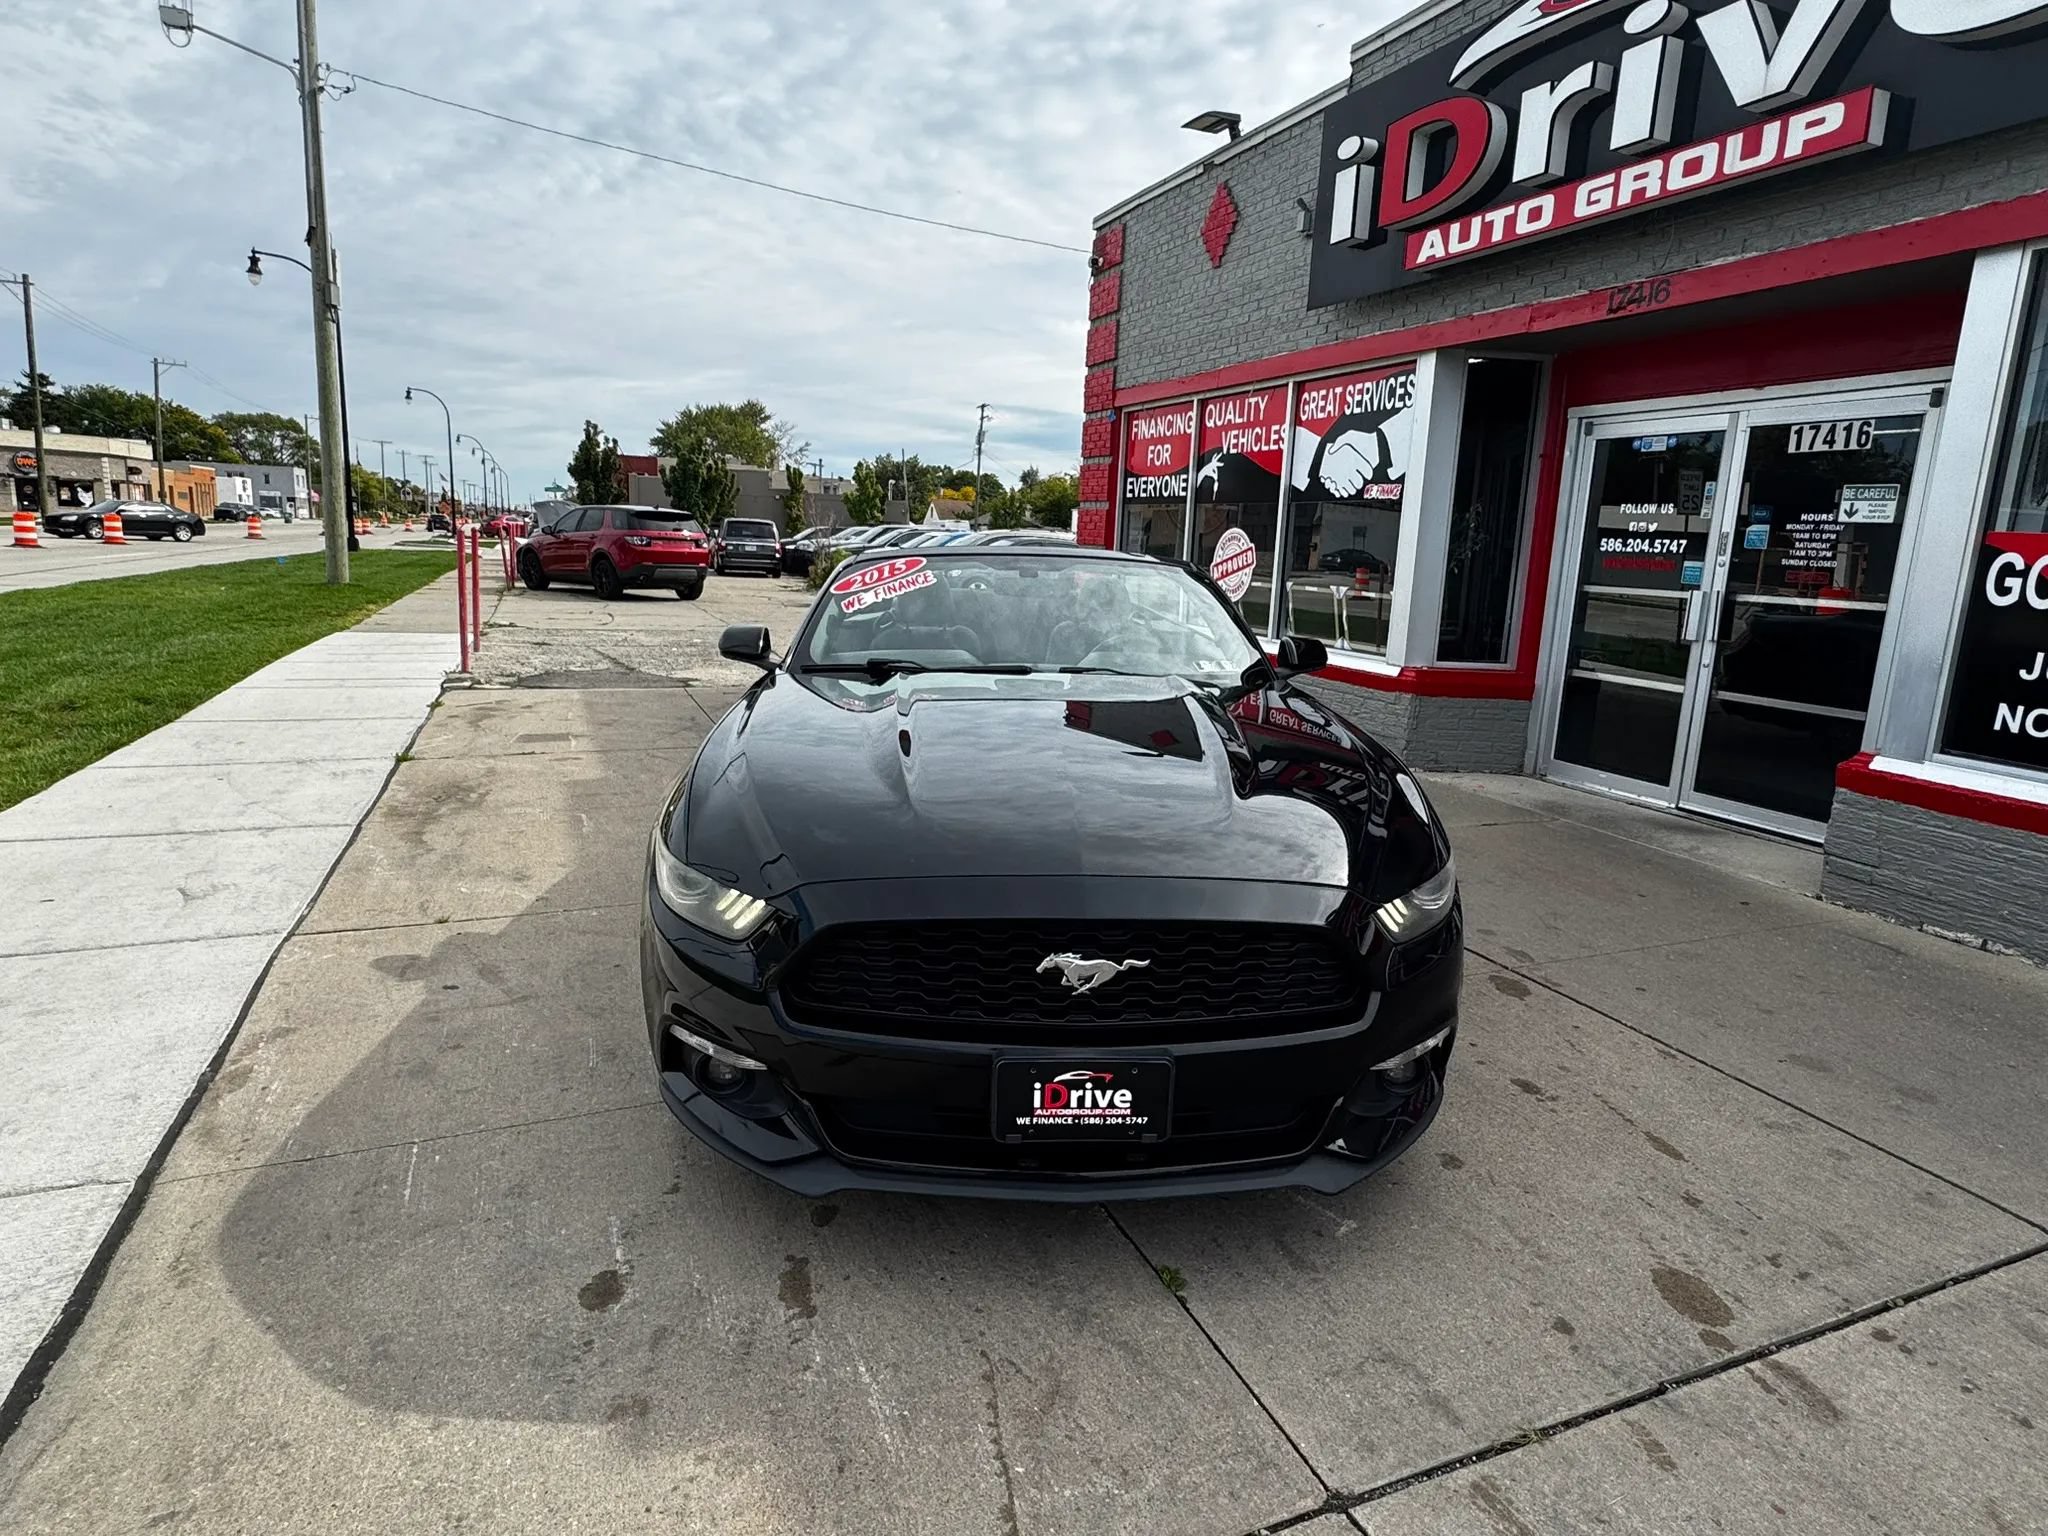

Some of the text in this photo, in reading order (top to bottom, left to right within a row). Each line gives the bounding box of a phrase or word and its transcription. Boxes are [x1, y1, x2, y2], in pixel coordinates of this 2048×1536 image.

[1330, 0, 2048, 247] iDriv
[1415, 101, 1847, 265] AUTO GROUP
[1606, 278, 1671, 316] 17416
[1205, 394, 1269, 428] QUALITY
[1299, 373, 1416, 421] GREAT SERVICES
[1131, 411, 1194, 441] FINANCING
[1221, 423, 1287, 455] VEHICLES
[1792, 420, 1872, 452] 17416
[1147, 443, 1172, 467] FOR
[1125, 473, 1188, 499] EVERYONE
[1844, 488, 1897, 499] BE CAREFUL
[1619, 503, 1675, 514] FOLLOW US
[1800, 513, 1834, 522] HOURS
[1599, 538, 1688, 554] 586.204.5747
[849, 560, 907, 590] 2015
[1213, 550, 1253, 580] APPROVED
[1809, 560, 1838, 568] CLOSED
[843, 571, 933, 611] WE FINANCE
[1033, 1082, 1133, 1108] iDrive
[1016, 1116, 1148, 1126] WE FINANCE (586) 204-5747
[1034, 1108, 1131, 1116] AUTOGROUP.COM
